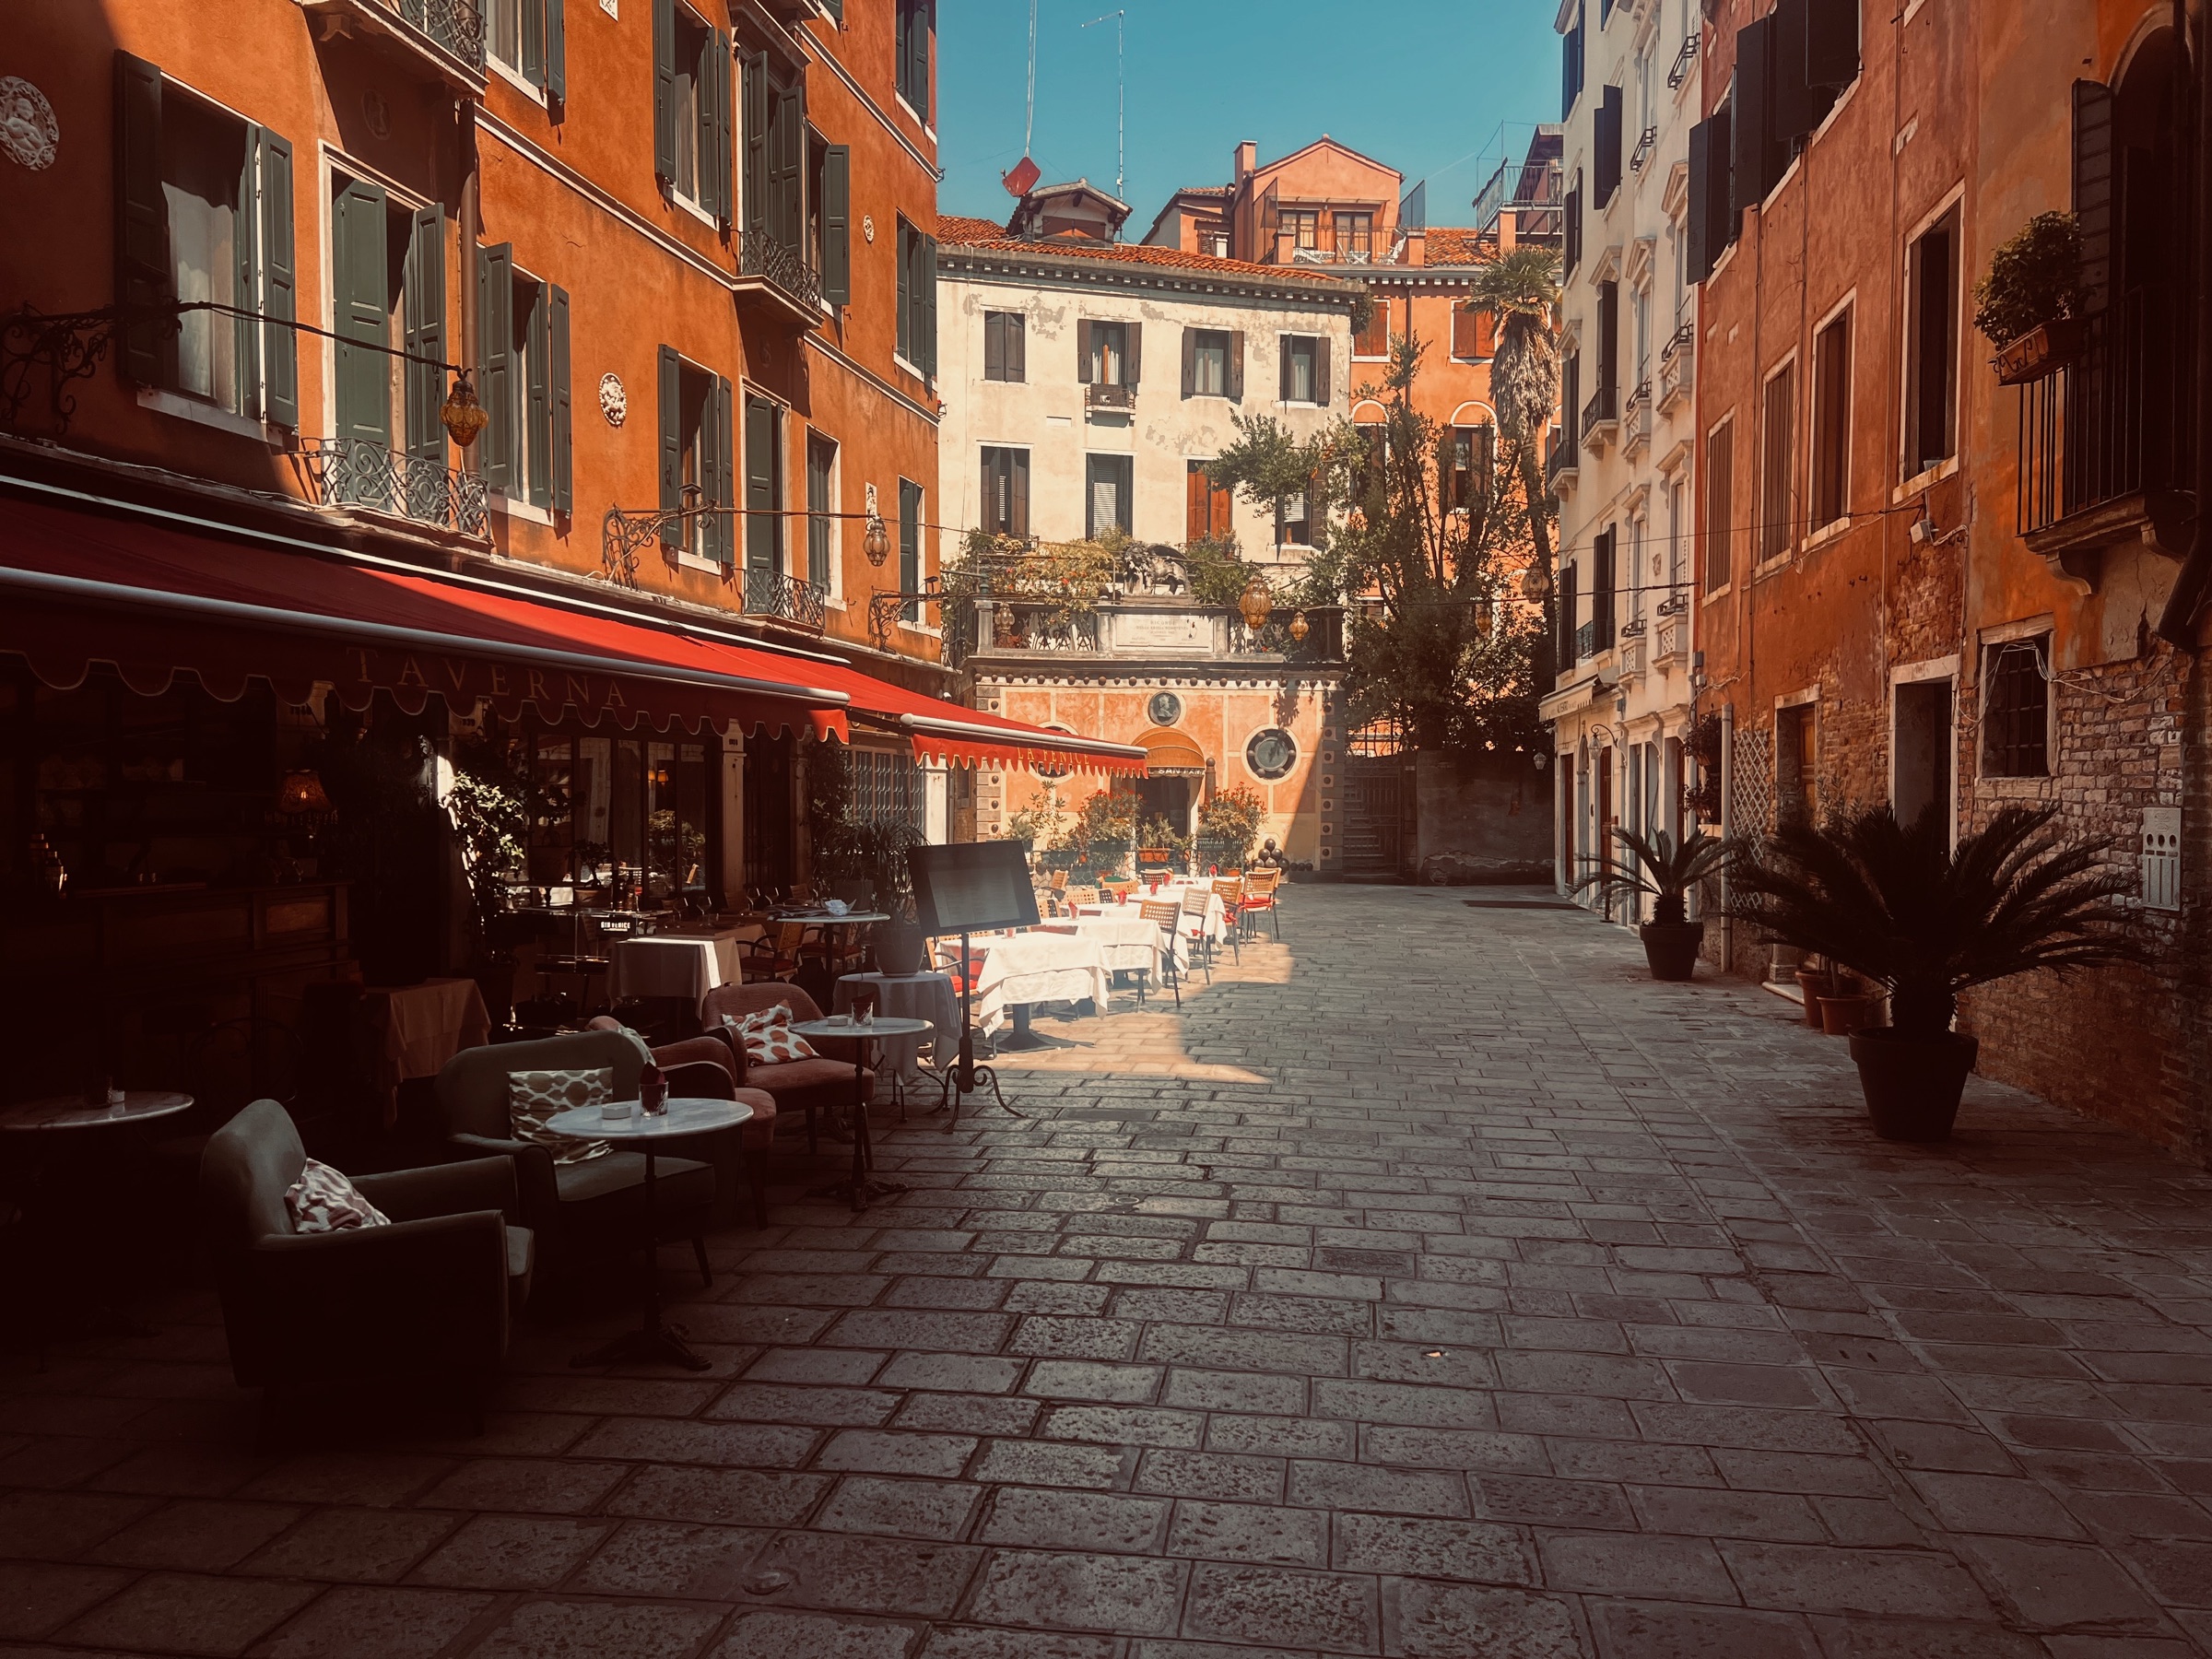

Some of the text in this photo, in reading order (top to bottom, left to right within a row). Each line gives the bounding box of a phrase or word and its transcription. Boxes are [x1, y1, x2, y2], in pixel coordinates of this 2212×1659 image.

[346, 646, 627, 707] TAVERNA
[1017, 746, 1089, 764] LA FENICE
